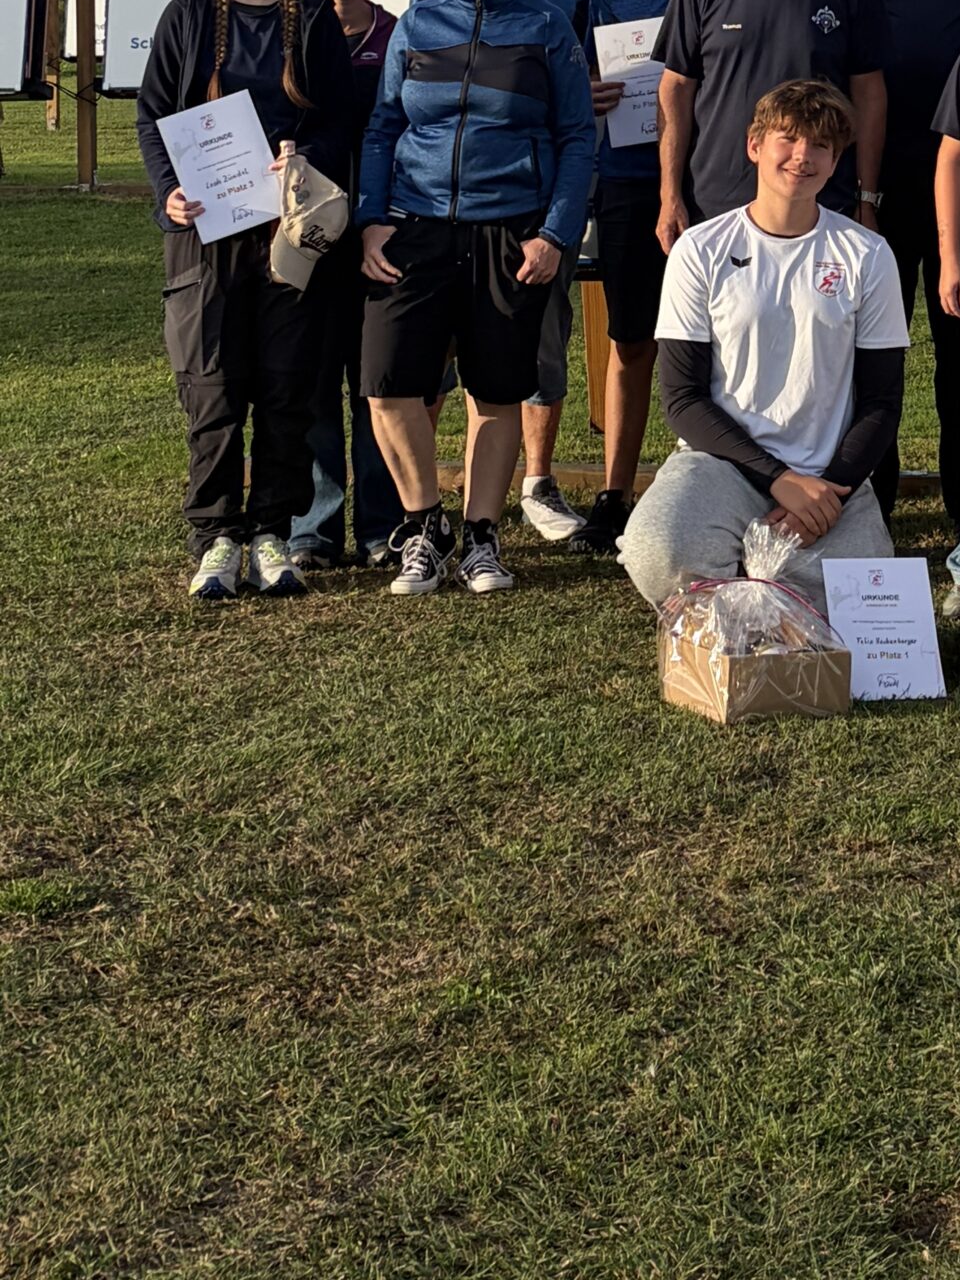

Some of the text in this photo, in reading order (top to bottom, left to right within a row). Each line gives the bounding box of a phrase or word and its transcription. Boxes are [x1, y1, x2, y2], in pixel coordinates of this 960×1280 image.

[200, 132, 233, 148] URKUNDE
[227, 183, 248, 196] Platz
[880, 651, 901, 659] Platz
[905, 651, 909, 659] 1
